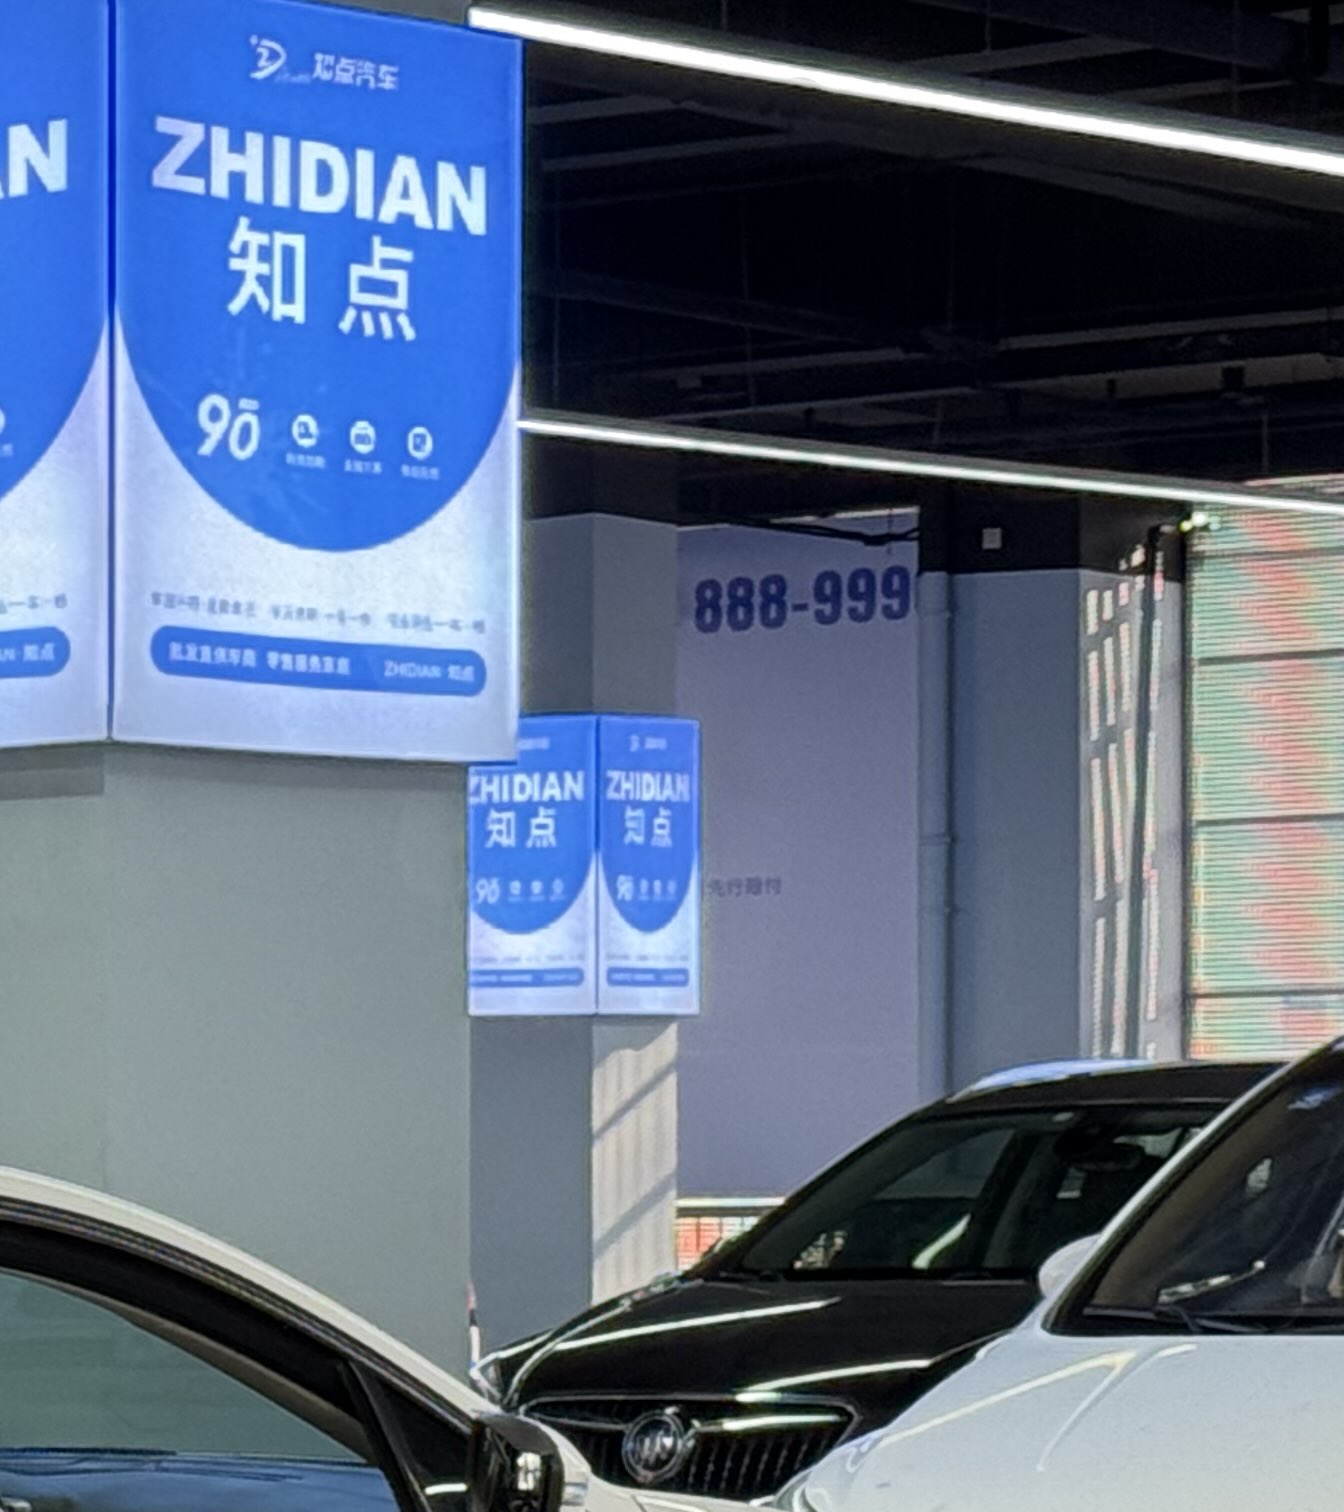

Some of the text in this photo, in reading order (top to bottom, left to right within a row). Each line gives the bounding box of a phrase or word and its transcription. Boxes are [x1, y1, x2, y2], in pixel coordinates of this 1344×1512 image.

[151, 116, 487, 236] ZHIDIAN
[227, 218, 416, 341] 知点
[695, 565, 911, 634] 888-999
[606, 771, 690, 802] ZHIDIAN
[486, 809, 556, 848] 知点
